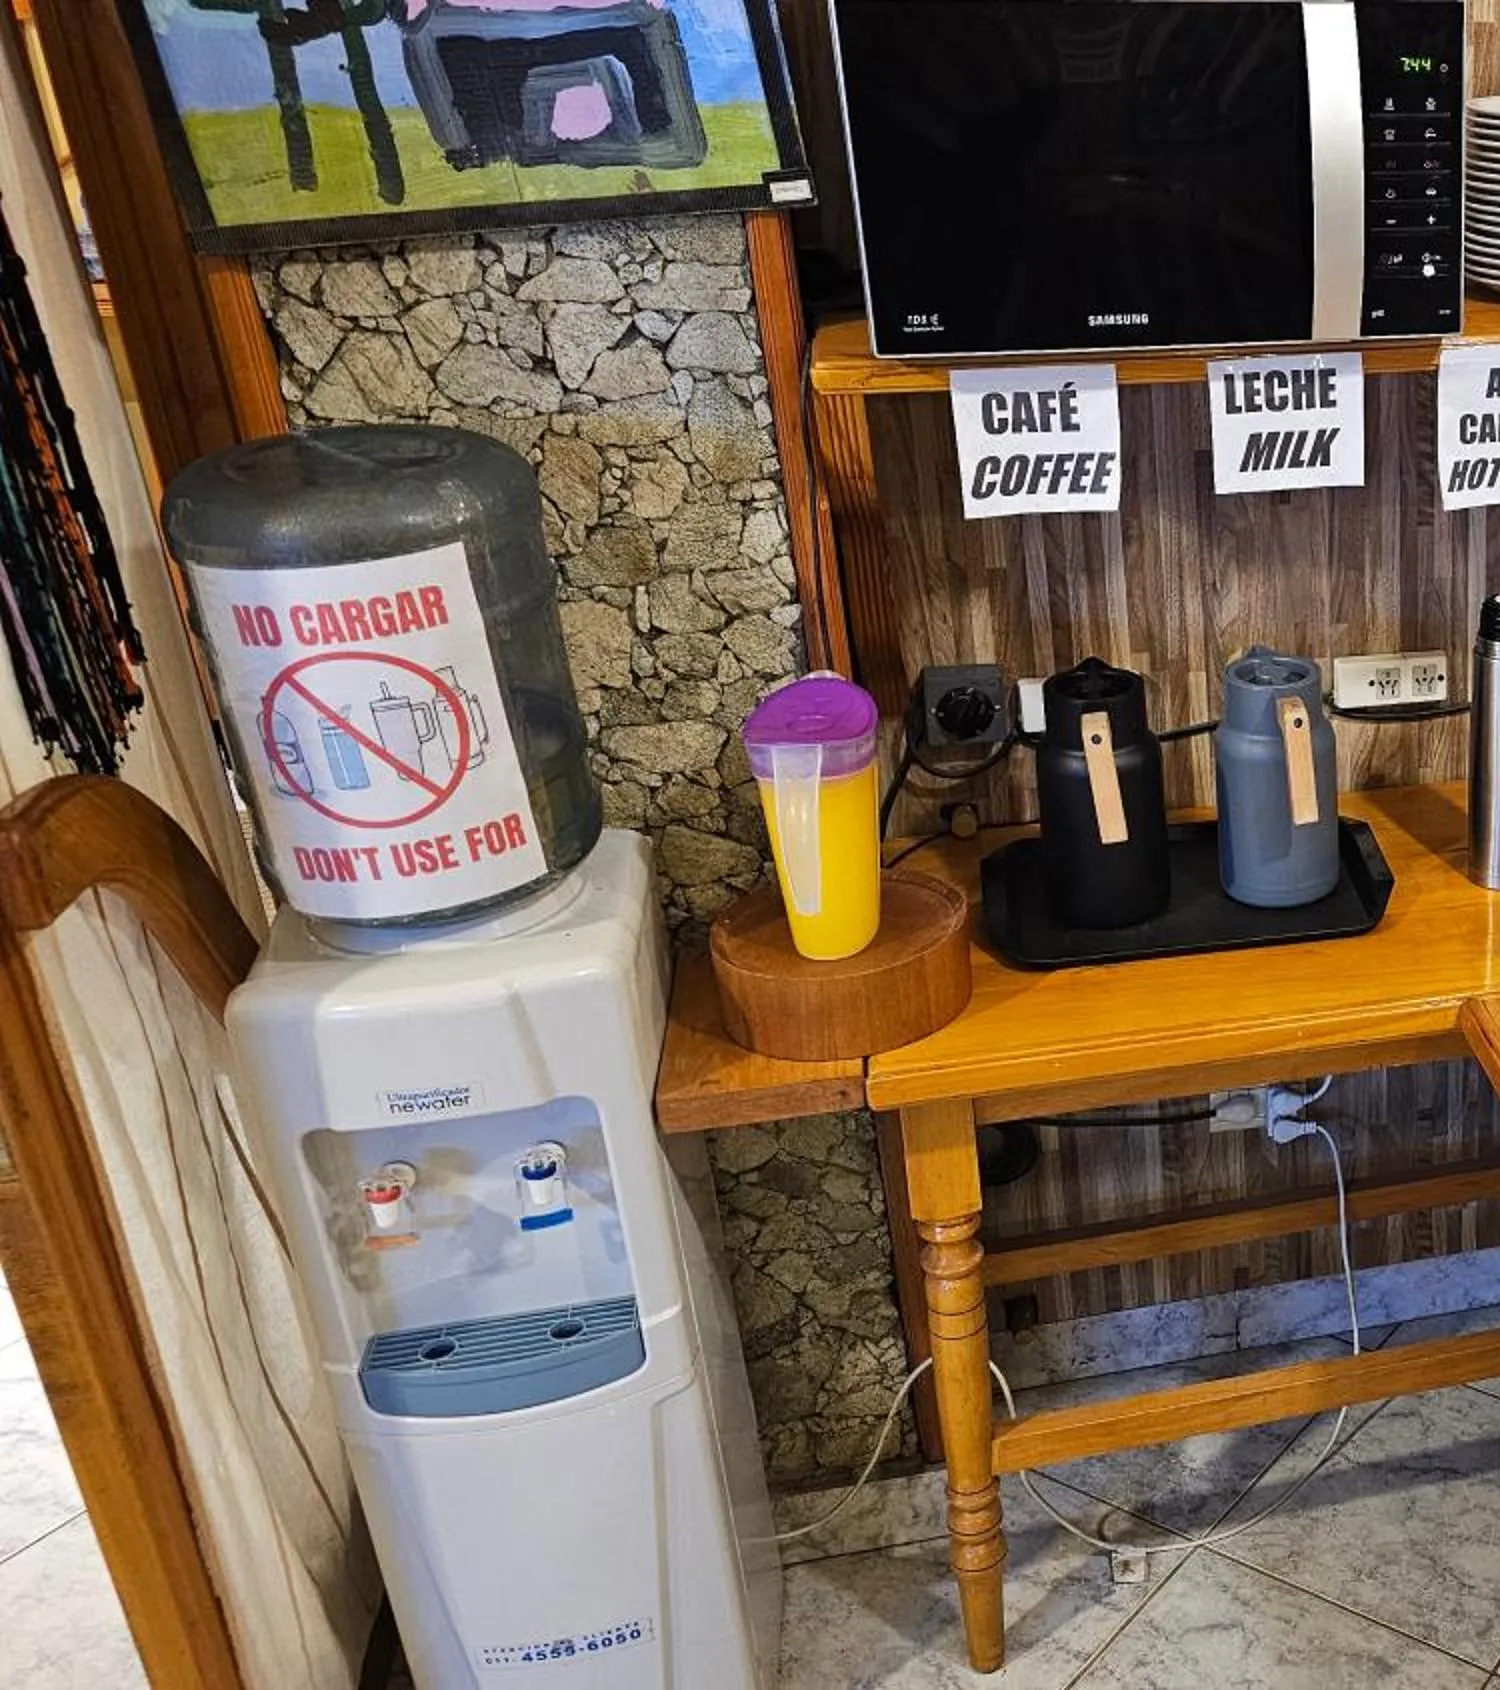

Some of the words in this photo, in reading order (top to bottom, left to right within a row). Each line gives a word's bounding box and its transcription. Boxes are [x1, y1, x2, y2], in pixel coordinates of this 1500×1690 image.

[1087, 313, 1149, 326] SAMSUNG
[981, 381, 1081, 435] CAFÉ
[1223, 366, 1338, 415] LECHE
[1239, 427, 1340, 474] MILK
[971, 452, 1116, 500] COFFEE
[232, 603, 283, 648] NO
[289, 585, 449, 647] CARGAR
[292, 844, 382, 883] DON'T
[389, 832, 460, 879] USE
[463, 812, 528, 864] FOR
[389, 1095, 471, 1114] newater
